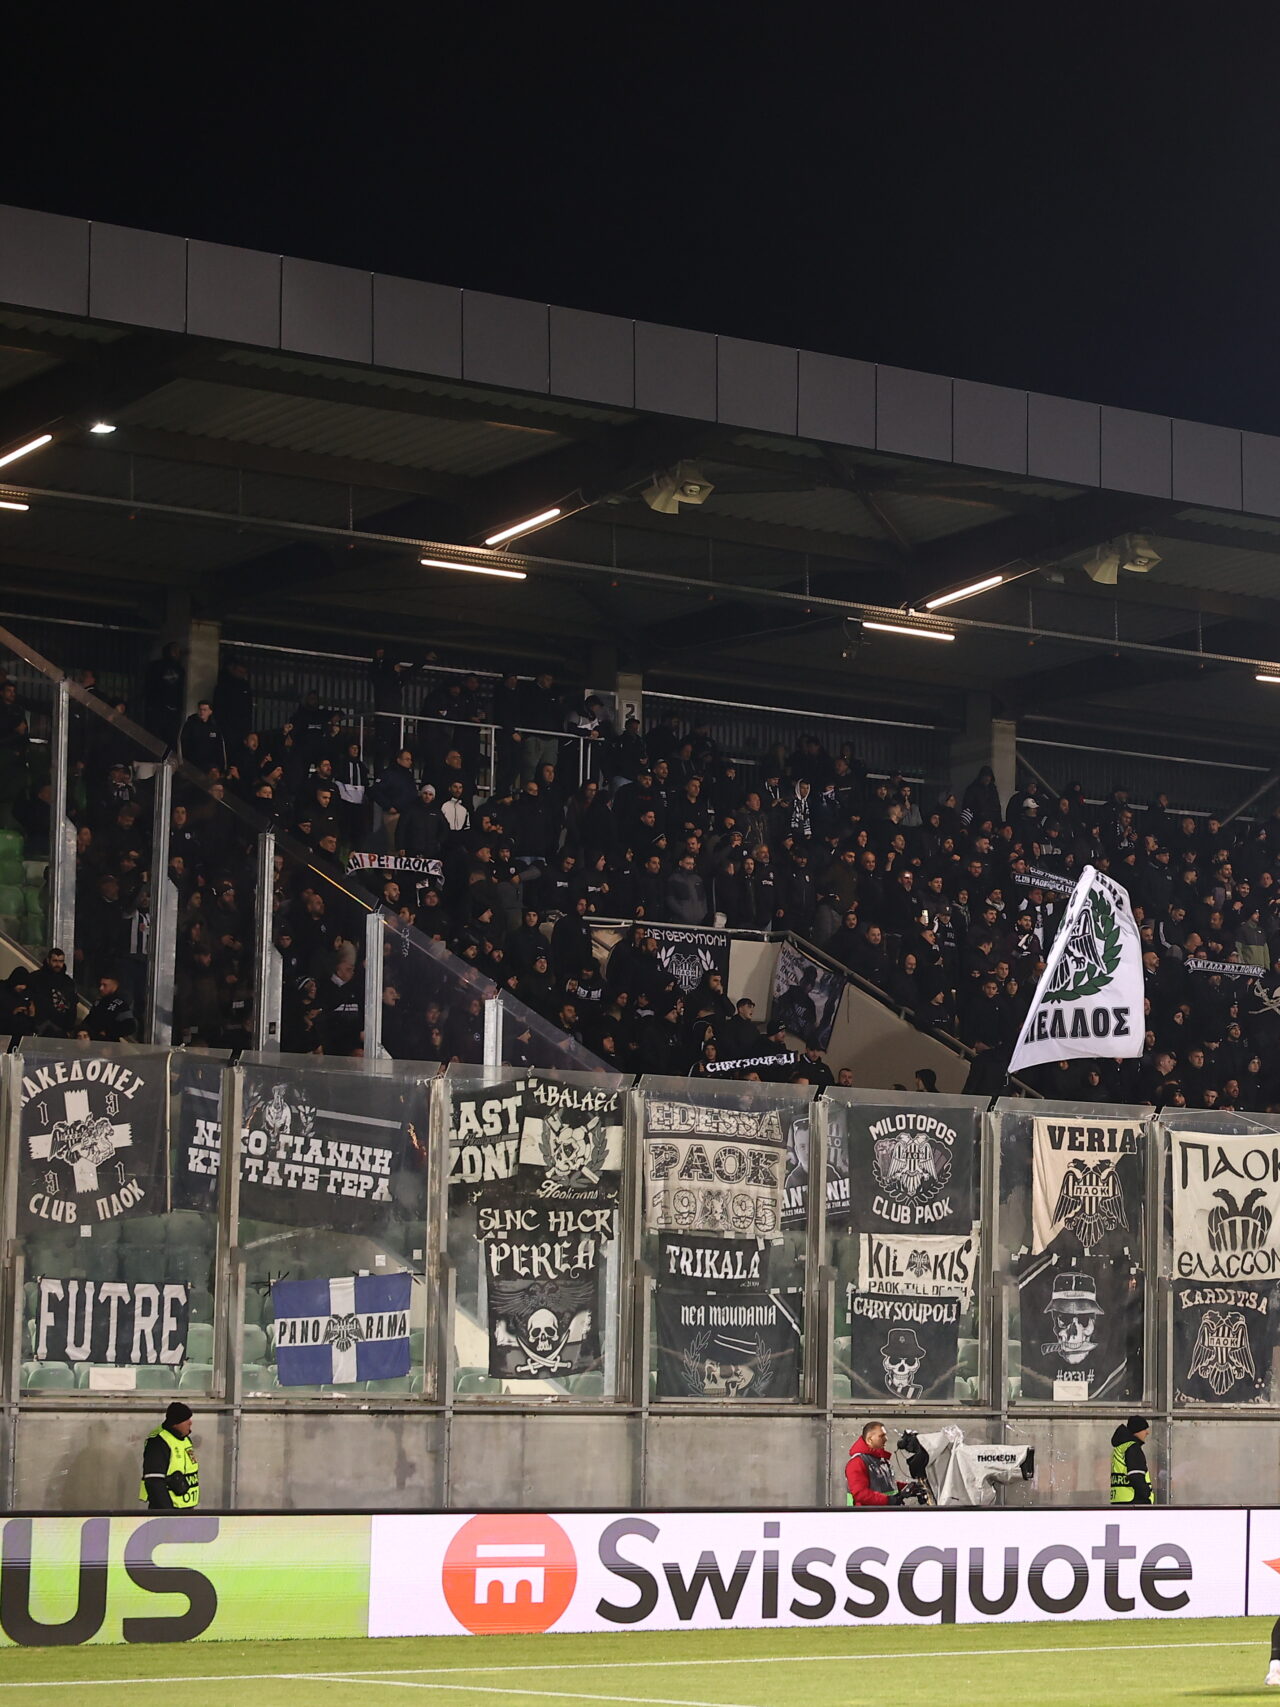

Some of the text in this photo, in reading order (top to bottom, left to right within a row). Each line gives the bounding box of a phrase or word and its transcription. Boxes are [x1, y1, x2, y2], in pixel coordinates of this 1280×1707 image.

[648, 1100, 783, 1142] EDESSA
[868, 1113, 958, 1147] MILOTOPOS
[193, 1119, 393, 1175] ΝΚΟ ΓΙΑΝΝΗ
[1047, 1125, 1138, 1153] VERIA
[188, 1147, 393, 1202] ΚΡΤΑΤΕ ΓΕΡΑ
[650, 1143, 780, 1188] PAOK
[29, 1193, 77, 1224] CLUB
[479, 1208, 613, 1234] SLNC HLCR
[652, 1189, 777, 1232] 19 95
[872, 1195, 953, 1225] CLUB PAOK
[489, 1240, 596, 1279] PEREA
[666, 1244, 761, 1279] TRIKALA
[869, 1281, 900, 1294] PAOK
[932, 1285, 968, 1297] DEH
[1179, 1287, 1268, 1315] KARDITSA
[38, 1278, 188, 1365] FUTRE
[853, 1296, 957, 1325] CHRYSOUPOLI
[278, 1312, 408, 1346] PANO RAMA
[595, 1516, 1193, 1624] Swissquote
